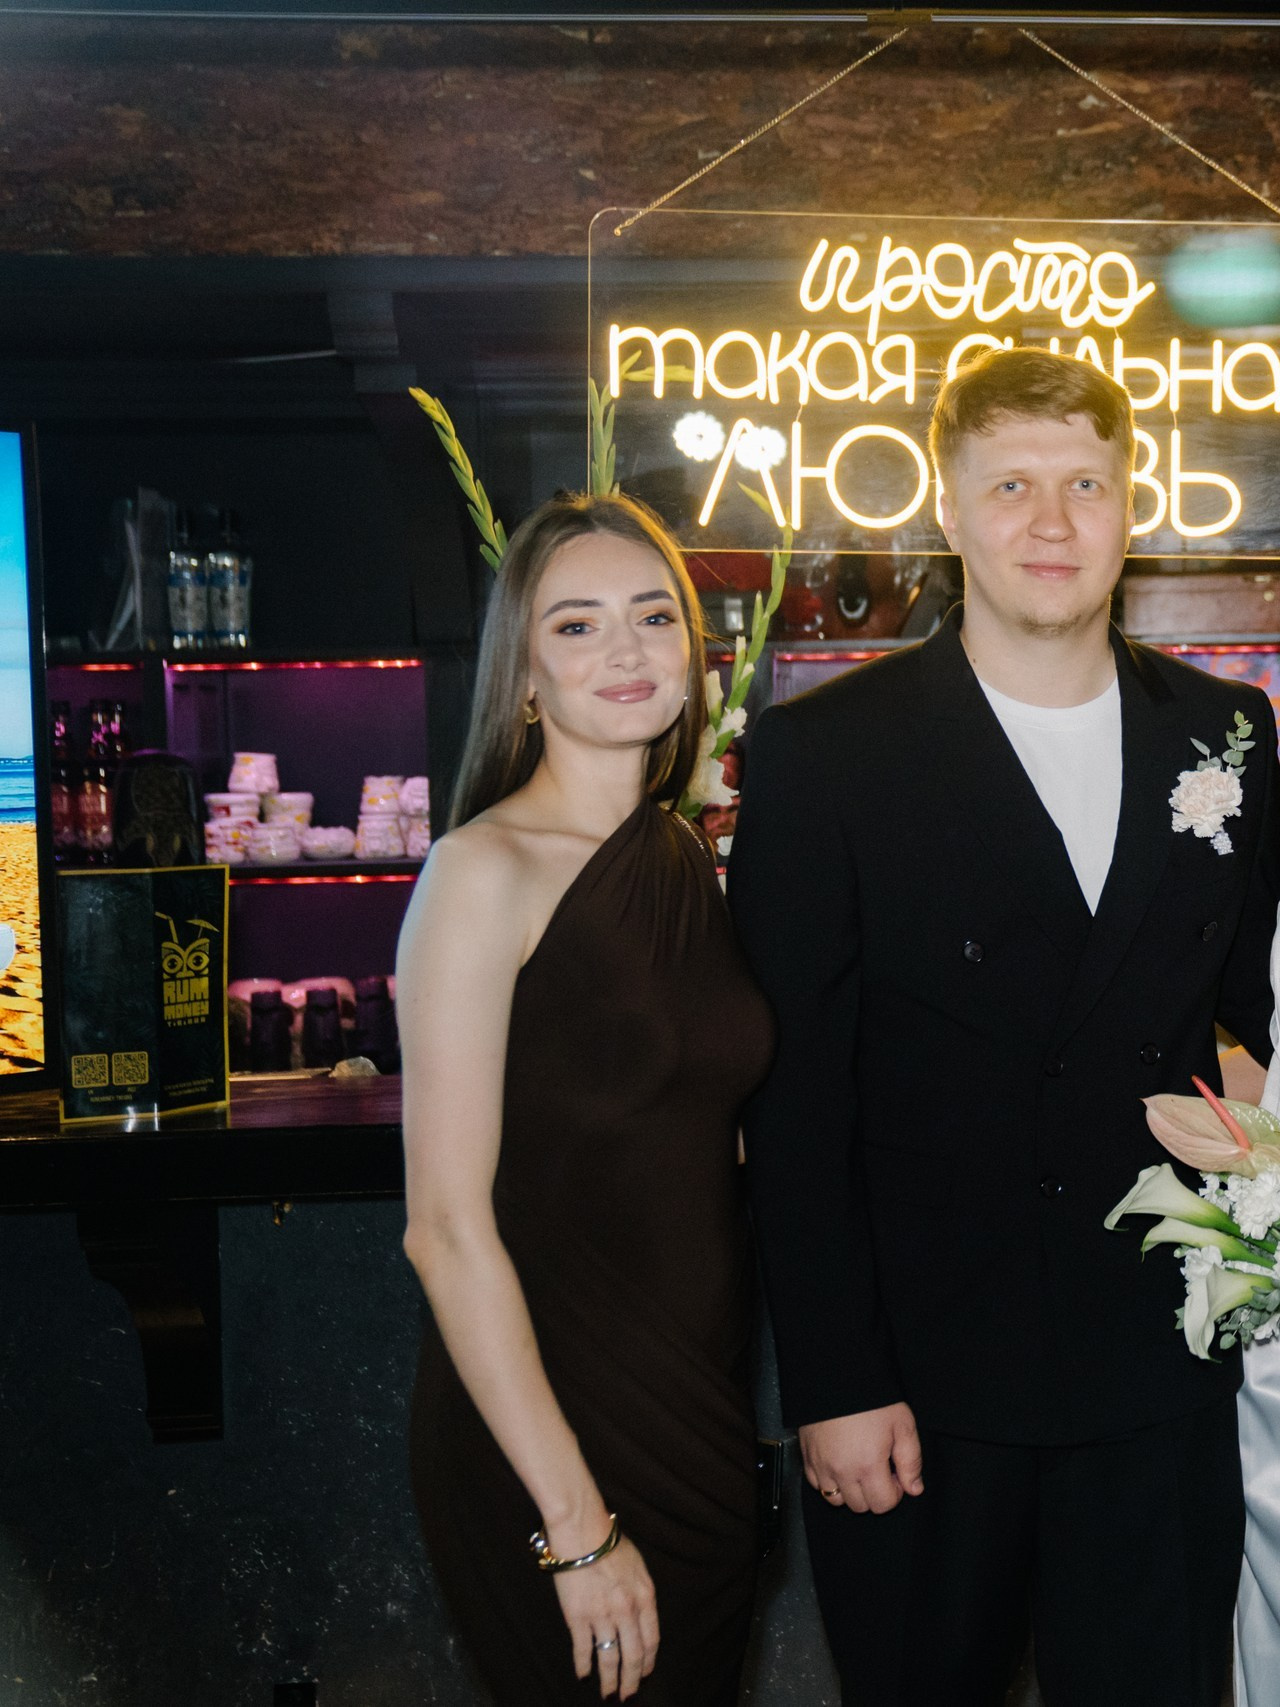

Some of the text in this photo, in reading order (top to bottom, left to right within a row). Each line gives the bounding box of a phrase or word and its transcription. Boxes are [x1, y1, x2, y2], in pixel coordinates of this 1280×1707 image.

[799, 236, 1155, 349] просто
[608, 324, 916, 405] такая
[698, 417, 1242, 538] ЛЮВЬ
[163, 976, 210, 1004] RUM
[164, 999, 210, 1021] MONEY
